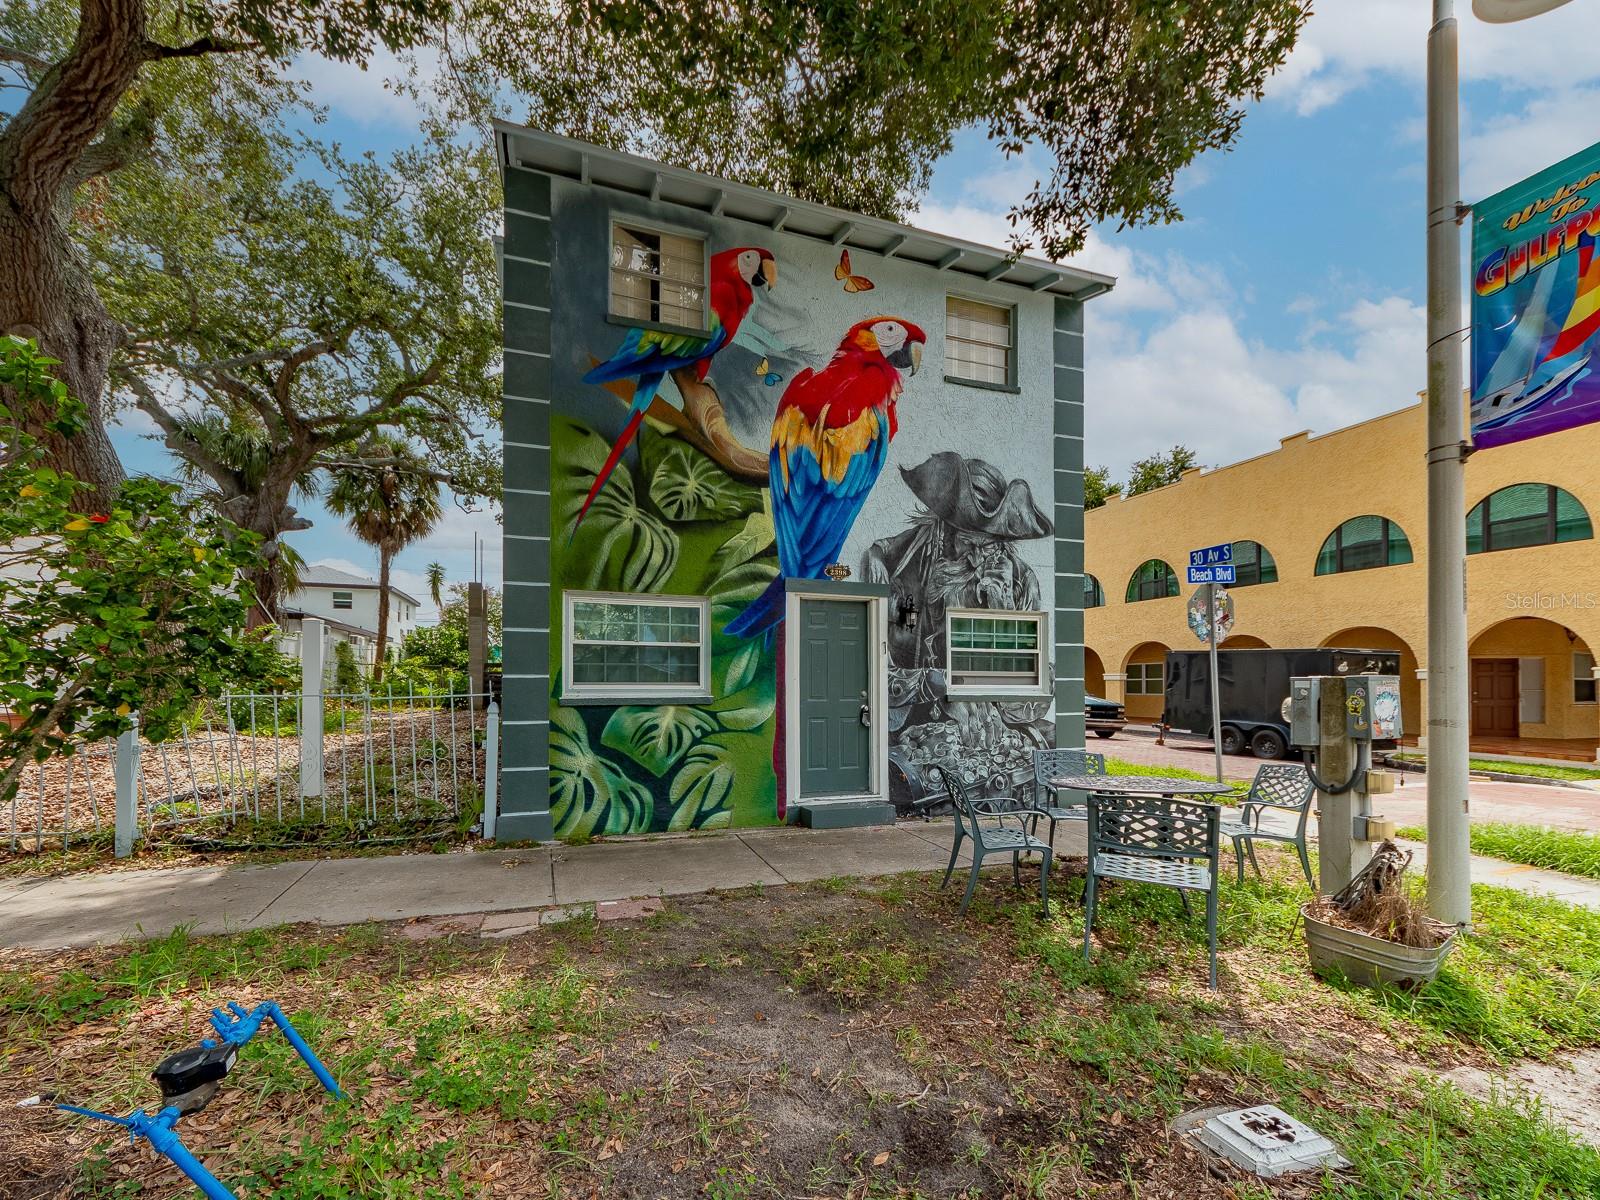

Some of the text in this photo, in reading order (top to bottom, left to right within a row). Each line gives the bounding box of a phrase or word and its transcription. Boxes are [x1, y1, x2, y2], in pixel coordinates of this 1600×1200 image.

[1502, 171, 1600, 232] Welco
[1550, 197, 1589, 224] To
[1192, 546, 1230, 566] 30 Av S
[1190, 567, 1232, 581] Beach Blvd
